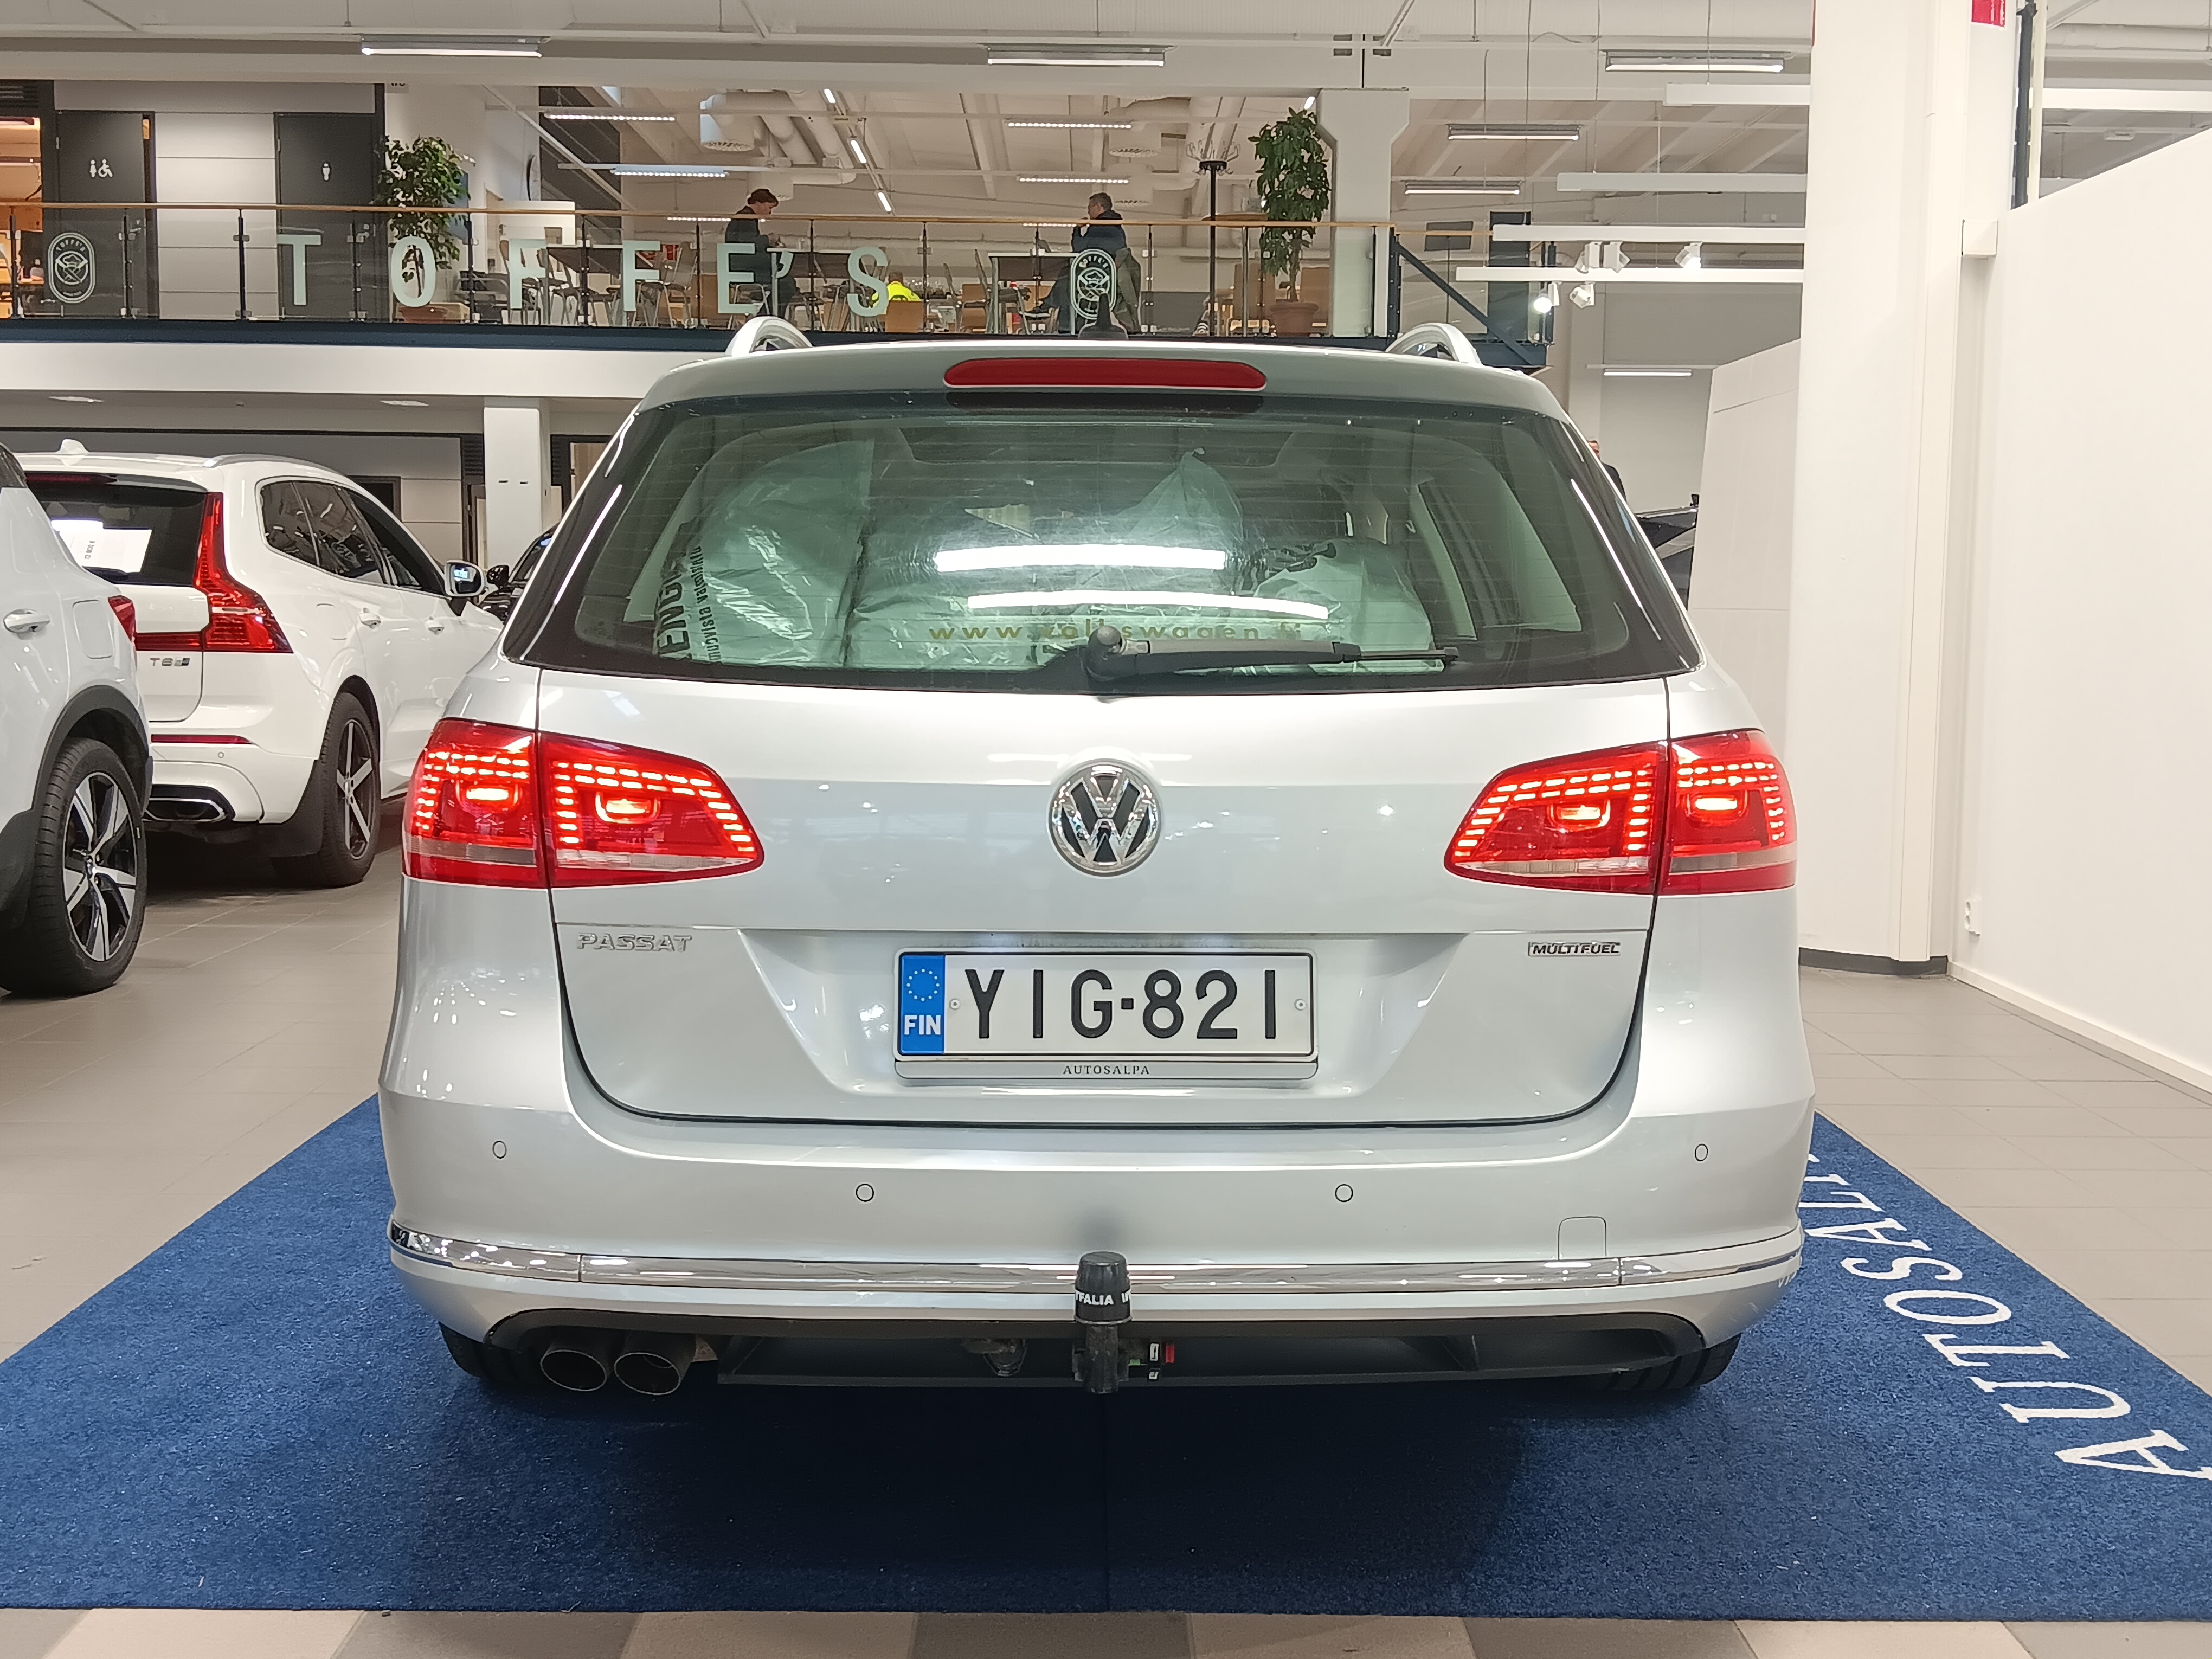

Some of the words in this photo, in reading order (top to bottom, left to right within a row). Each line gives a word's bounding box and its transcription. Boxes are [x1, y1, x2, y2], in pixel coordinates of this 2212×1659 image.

[276, 234, 889, 317] TOFFE'S
[929, 618, 1301, 640] www.volswagen.fi
[577, 933, 692, 952] PASSAT
[1532, 944, 1619, 954] MULTIFUEL
[965, 969, 1277, 1039] YIG-821
[904, 1014, 941, 1035] FIN
[1063, 1065, 1150, 1075] AUTOSALPA
[1798, 1154, 2212, 1480] AUTOSAL
